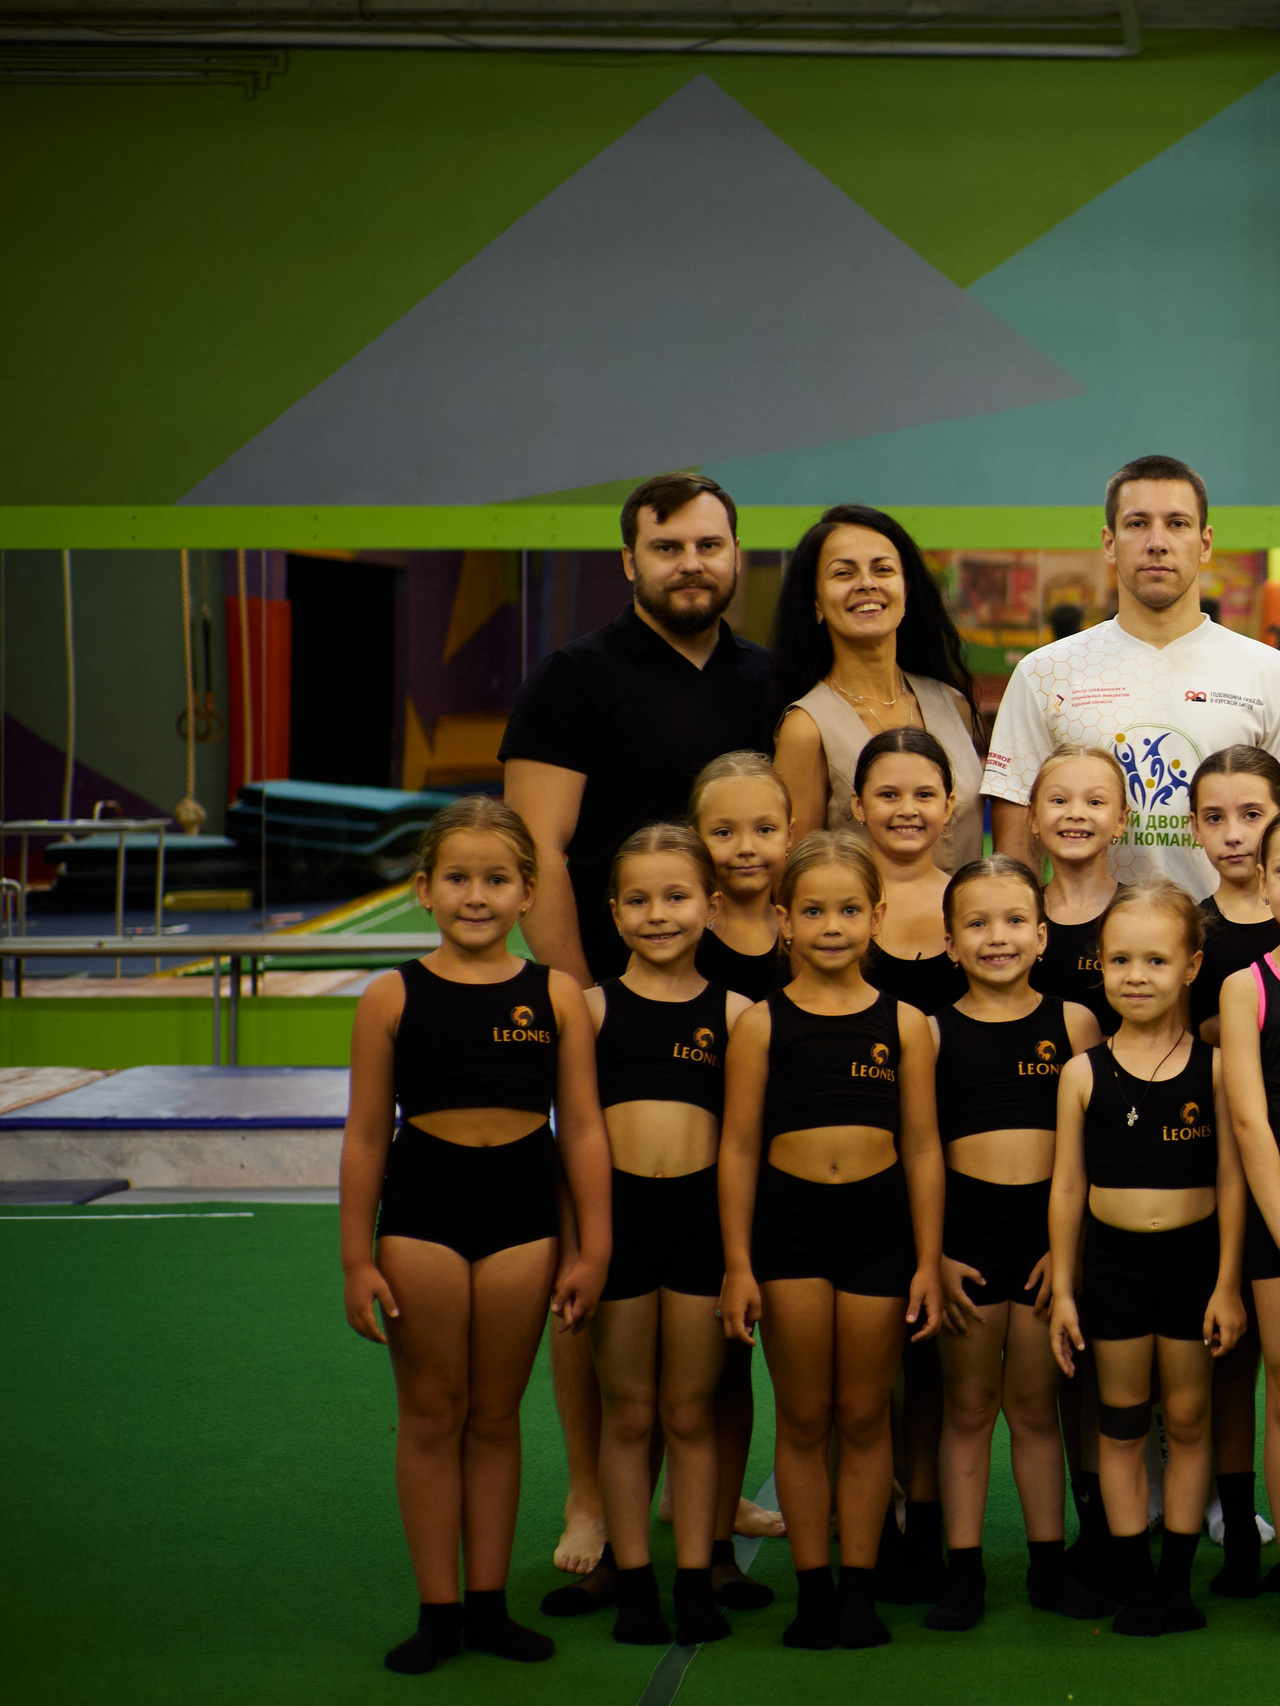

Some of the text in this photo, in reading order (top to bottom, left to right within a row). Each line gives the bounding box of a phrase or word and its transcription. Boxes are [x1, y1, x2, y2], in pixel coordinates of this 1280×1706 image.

[1210, 691, 1242, 701] ГОДОВЩИНА
[1145, 814, 1190, 831] ДВОР
[493, 1027, 550, 1044] LEONES
[851, 1062, 895, 1082] LEONES
[1018, 1061, 1064, 1076] LEON
[1162, 1125, 1211, 1141] LEONES
